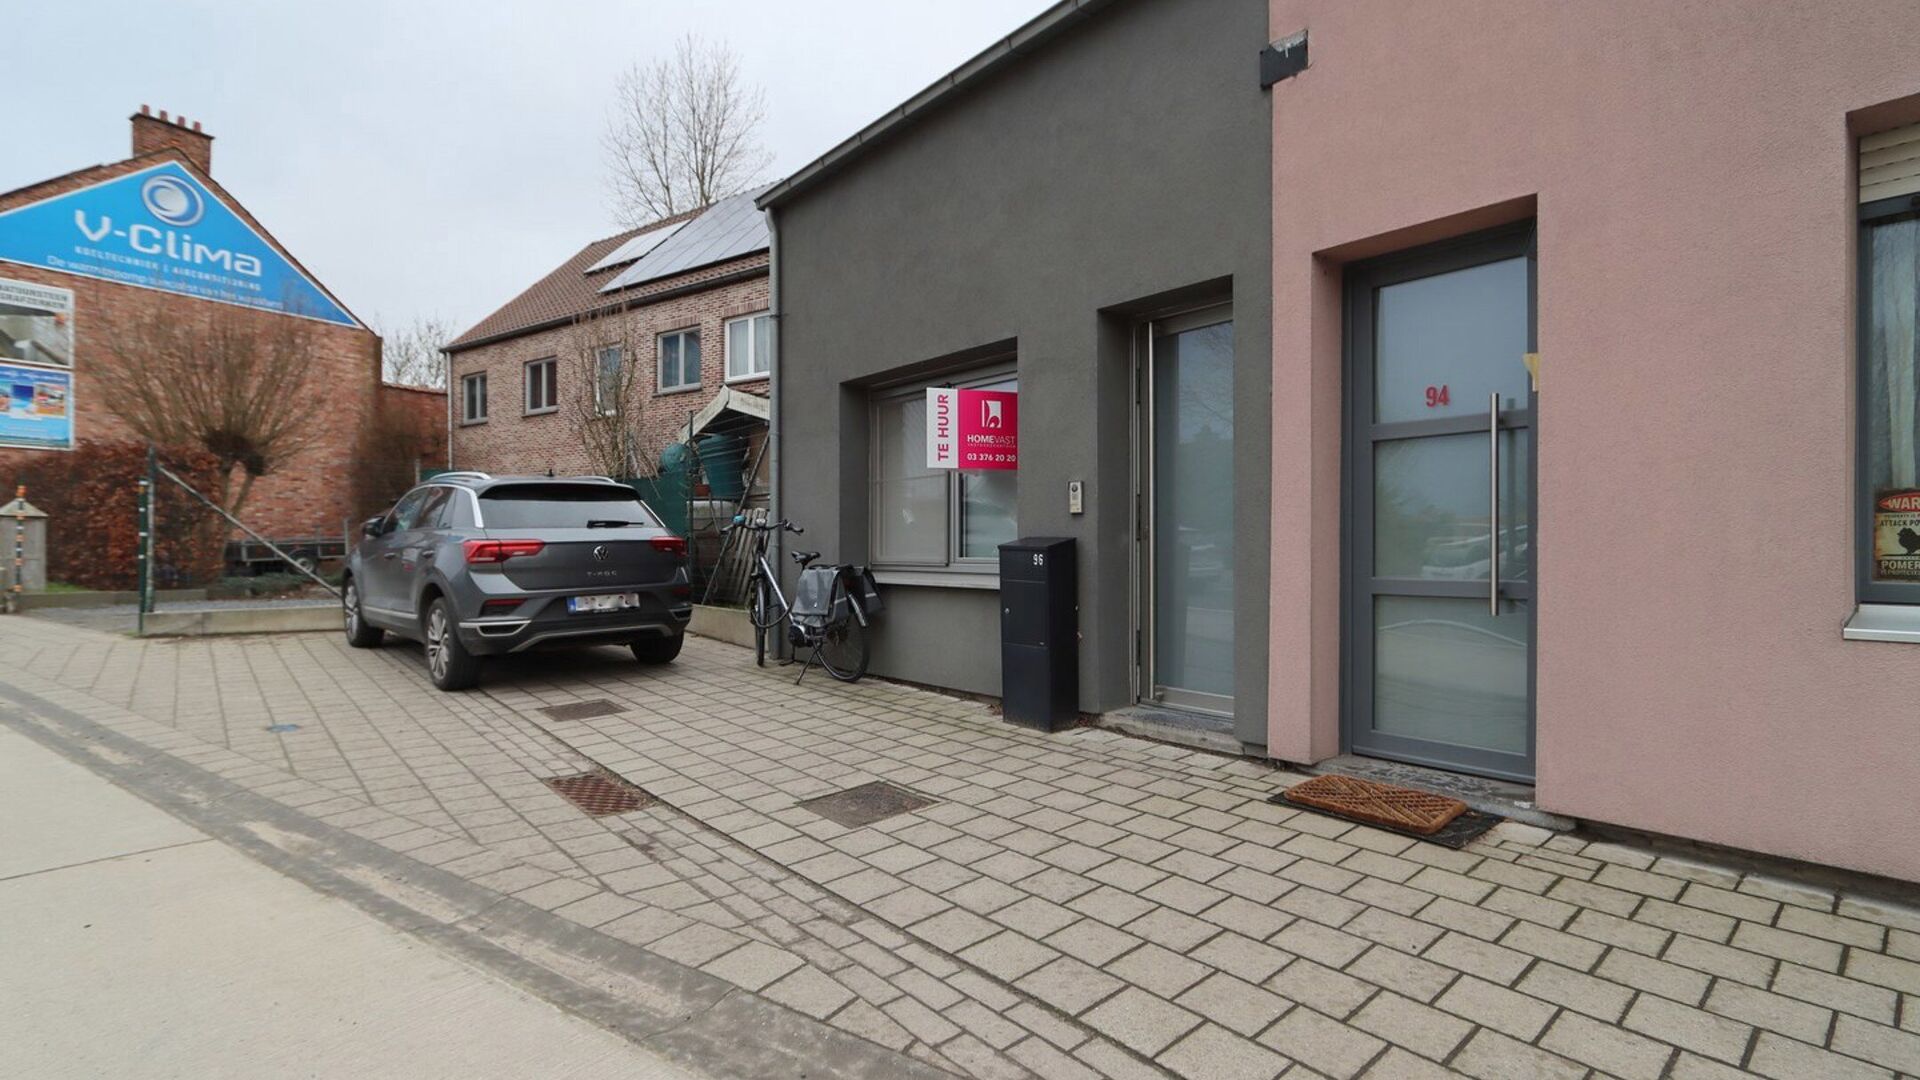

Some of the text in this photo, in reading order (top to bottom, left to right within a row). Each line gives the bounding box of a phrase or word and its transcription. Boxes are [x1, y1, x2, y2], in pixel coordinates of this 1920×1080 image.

[1426, 384, 1449, 408] 94
[937, 394, 949, 462] TE HUUR
[967, 434, 1015, 444] HOMEVAST
[967, 453, 977, 461] 03
[995, 454, 1005, 462] 20
[1007, 454, 1016, 462] 20
[1880, 519, 1907, 527] ATTACK
[1033, 553, 1043, 566] 96
